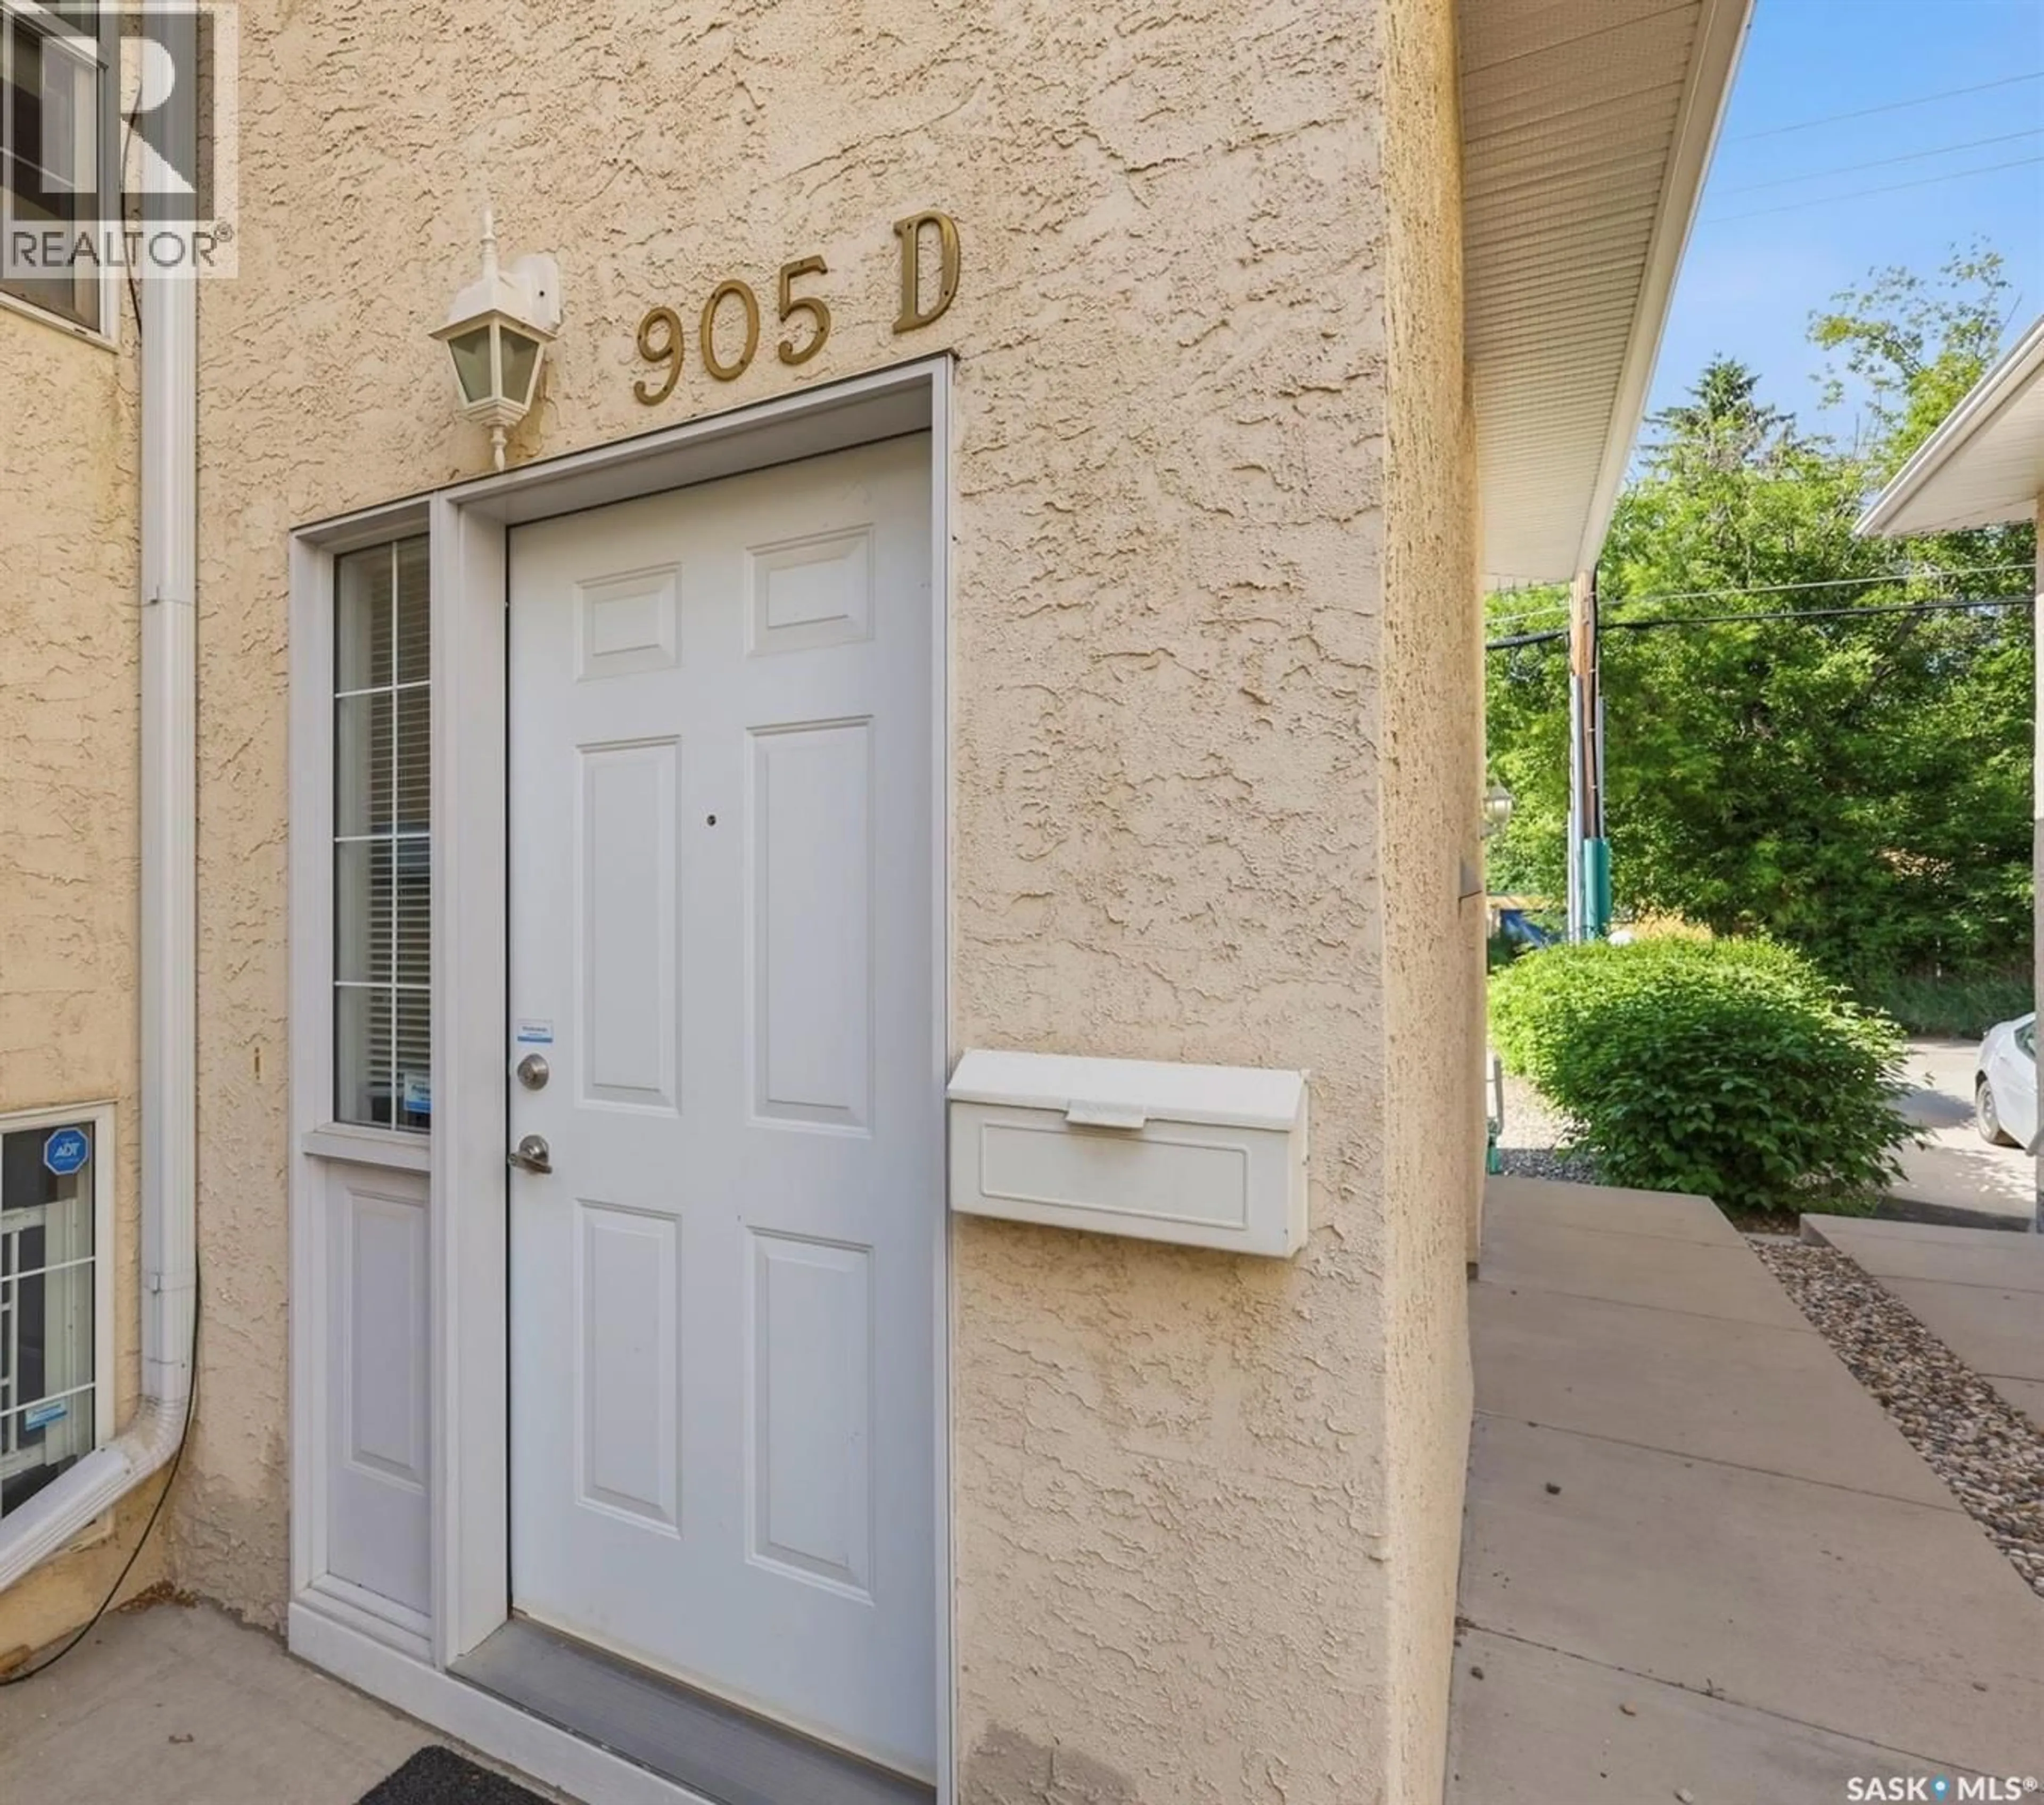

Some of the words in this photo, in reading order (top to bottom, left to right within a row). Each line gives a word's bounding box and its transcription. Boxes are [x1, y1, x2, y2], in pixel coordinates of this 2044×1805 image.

[633, 254, 831, 406] 905
[893, 210, 959, 334] D
[54, 1143, 79, 1158] ADT
